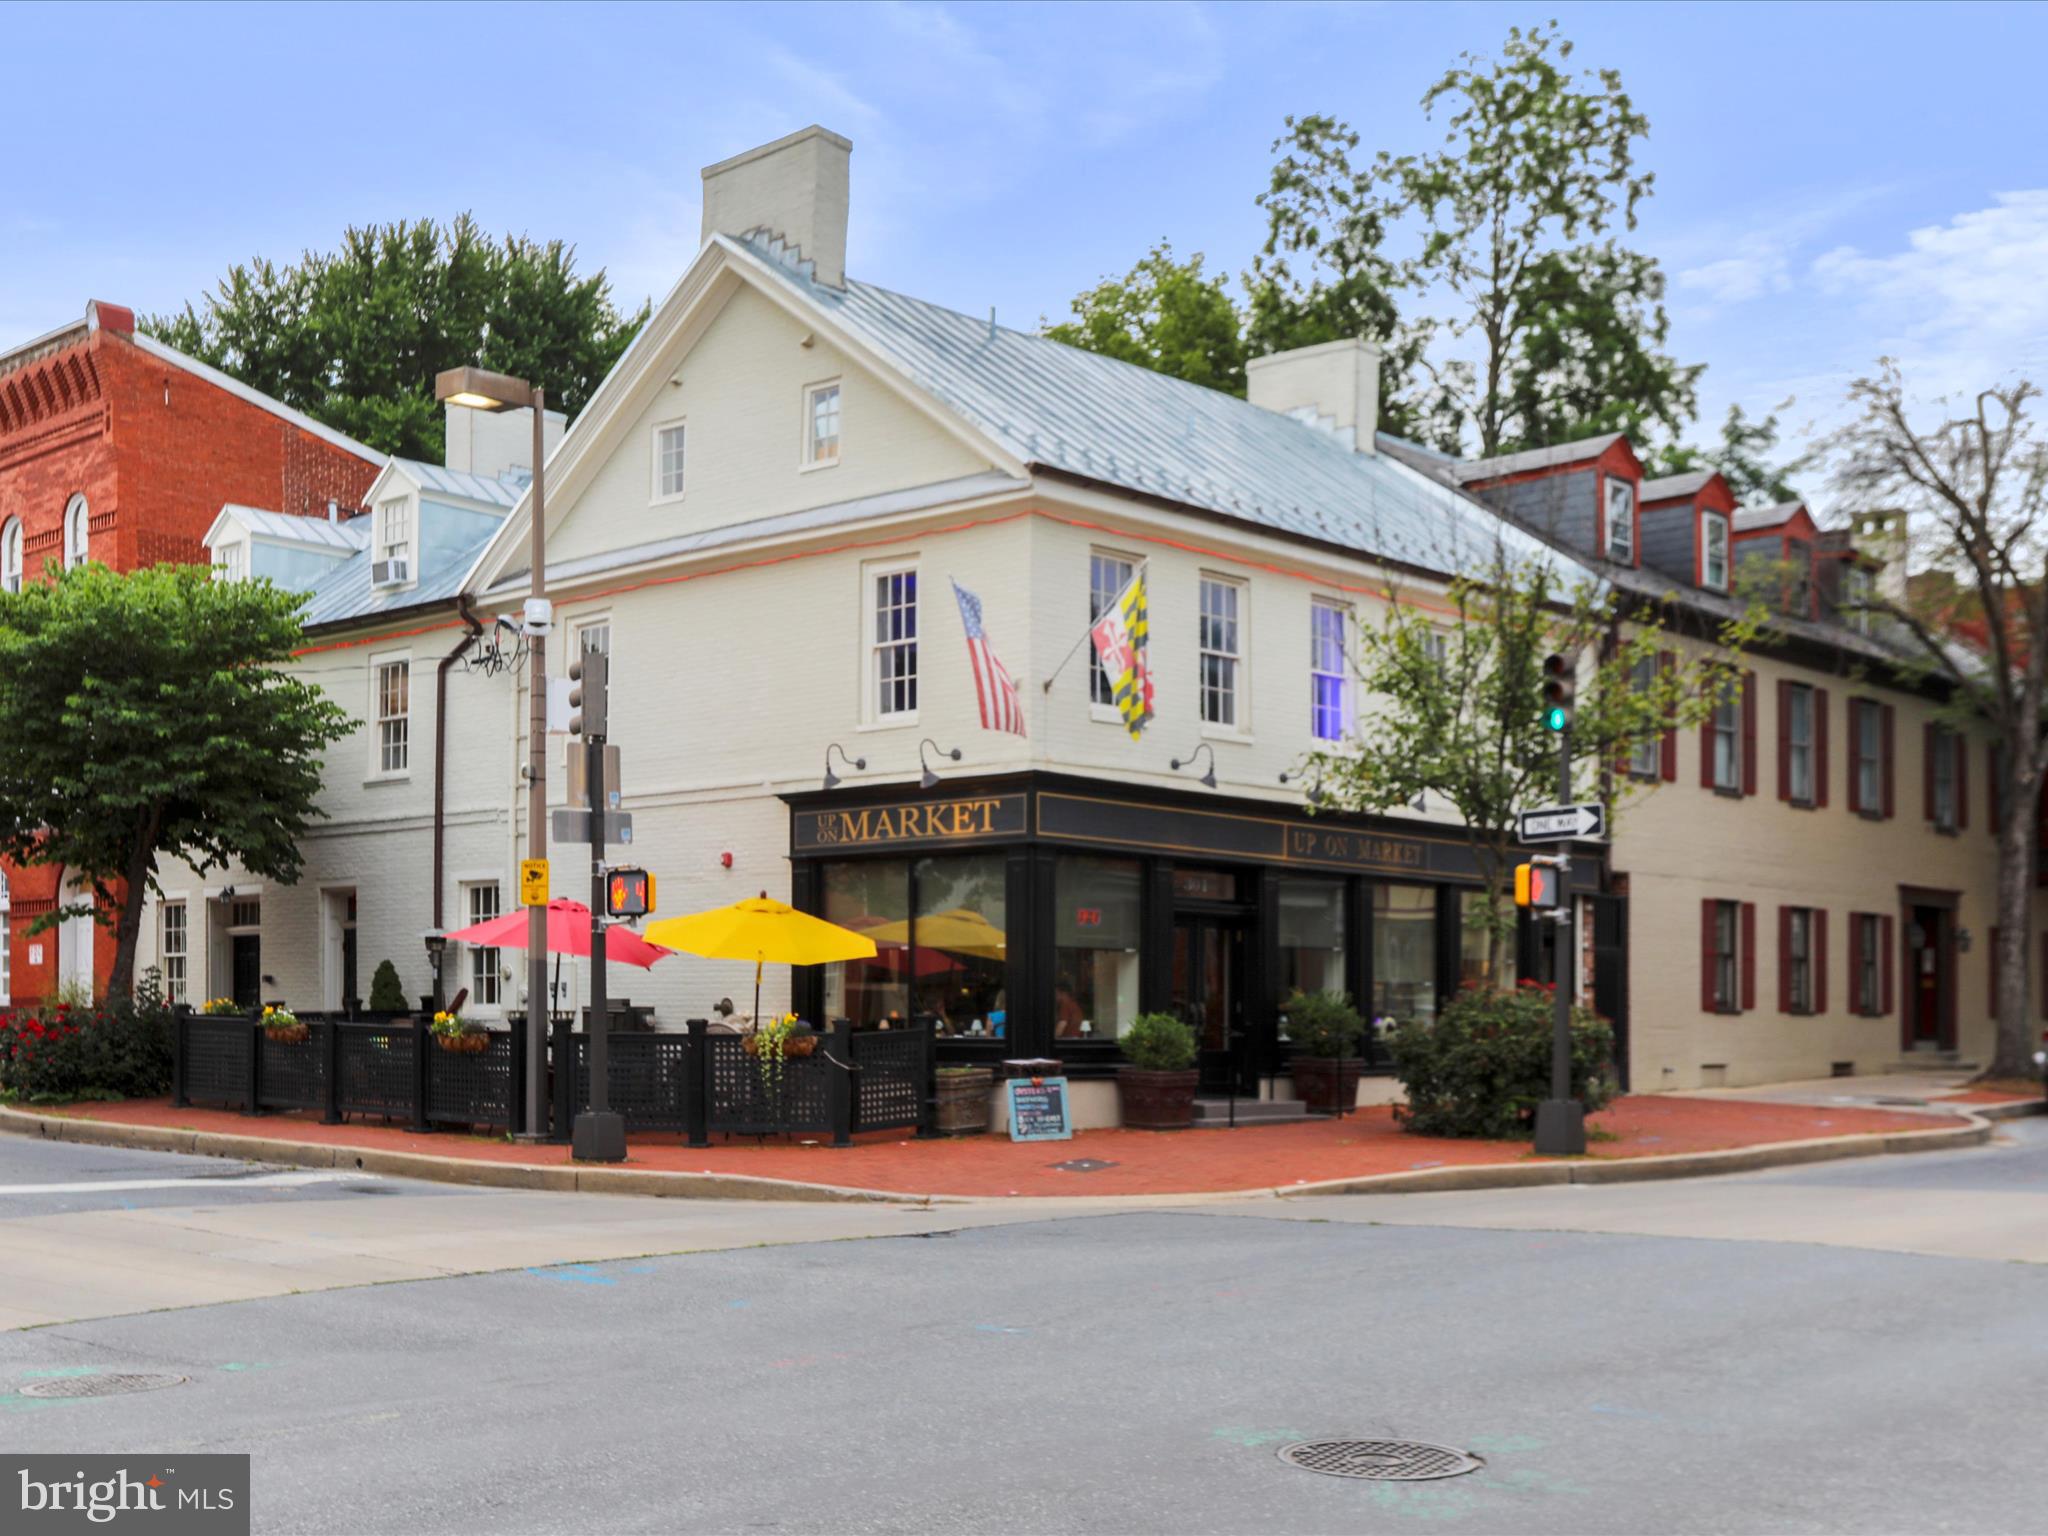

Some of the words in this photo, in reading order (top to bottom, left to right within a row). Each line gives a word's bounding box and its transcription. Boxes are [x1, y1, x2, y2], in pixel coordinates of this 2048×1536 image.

[817, 814, 836, 828] UP
[839, 800, 1001, 842] MARKET
[816, 831, 837, 843] ON
[1294, 831, 1317, 854] UP
[1325, 834, 1348, 856] ON
[1357, 839, 1421, 865] MARKET
